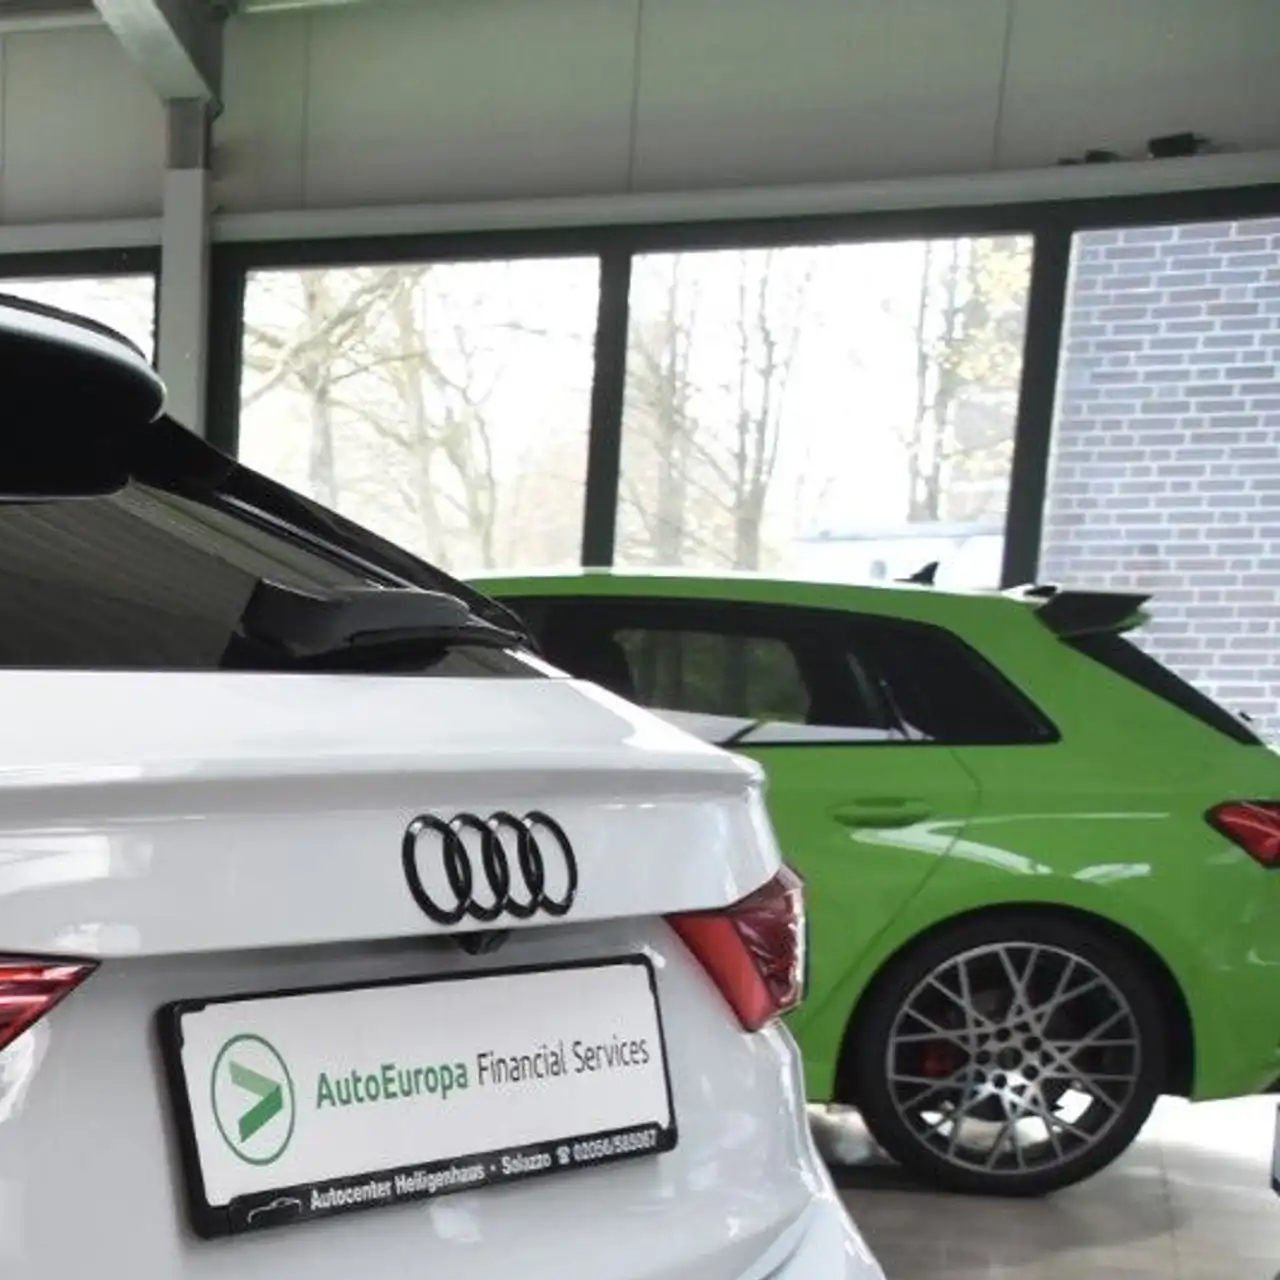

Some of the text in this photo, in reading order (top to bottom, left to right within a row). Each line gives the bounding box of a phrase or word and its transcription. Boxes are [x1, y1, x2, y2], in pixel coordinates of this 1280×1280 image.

[316, 1034, 650, 1108] AutoEuropa Financial Services
[310, 1181, 391, 1210] Autocenter
[394, 1164, 485, 1194] Heiligenhaus
